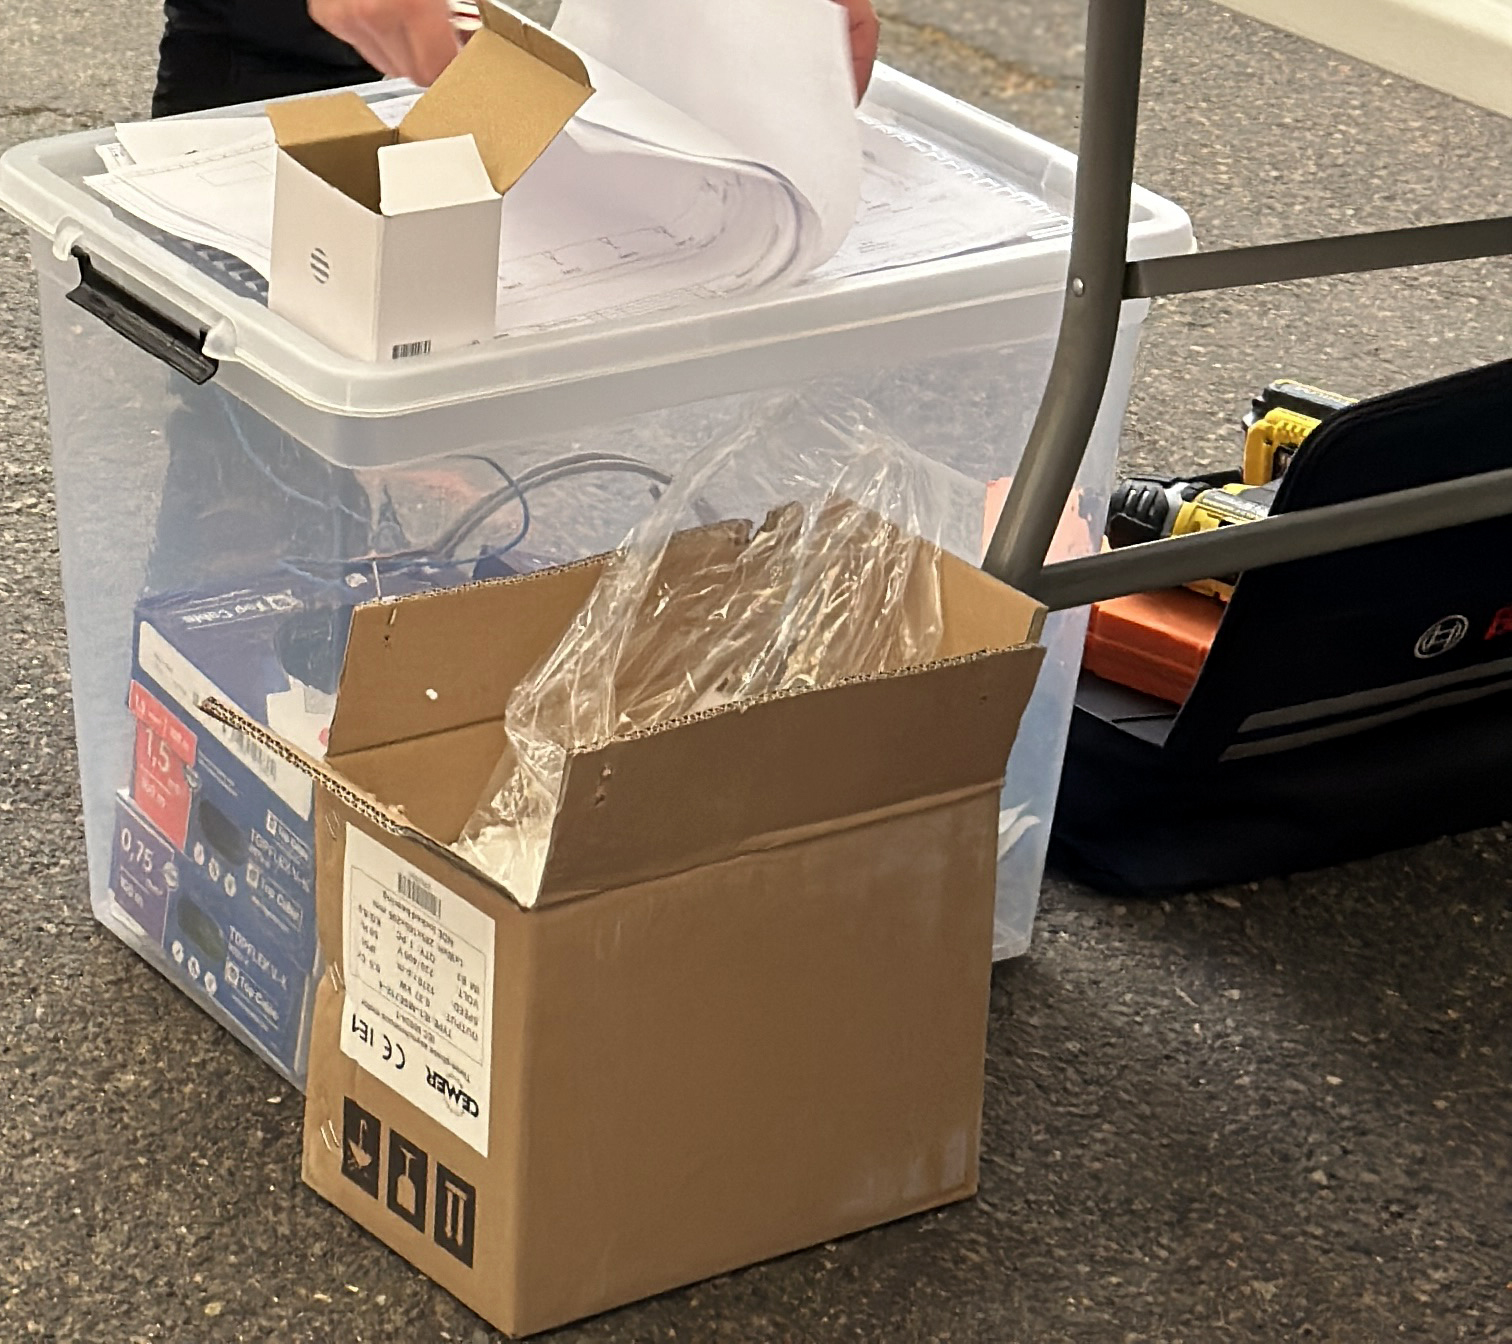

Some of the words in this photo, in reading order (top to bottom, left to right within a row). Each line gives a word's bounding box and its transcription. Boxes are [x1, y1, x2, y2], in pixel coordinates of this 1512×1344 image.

[144, 724, 170, 781] 1,5
[120, 822, 153, 883] 0,75
[351, 1011, 373, 1047] IE1
[425, 1064, 478, 1120] CEMER
